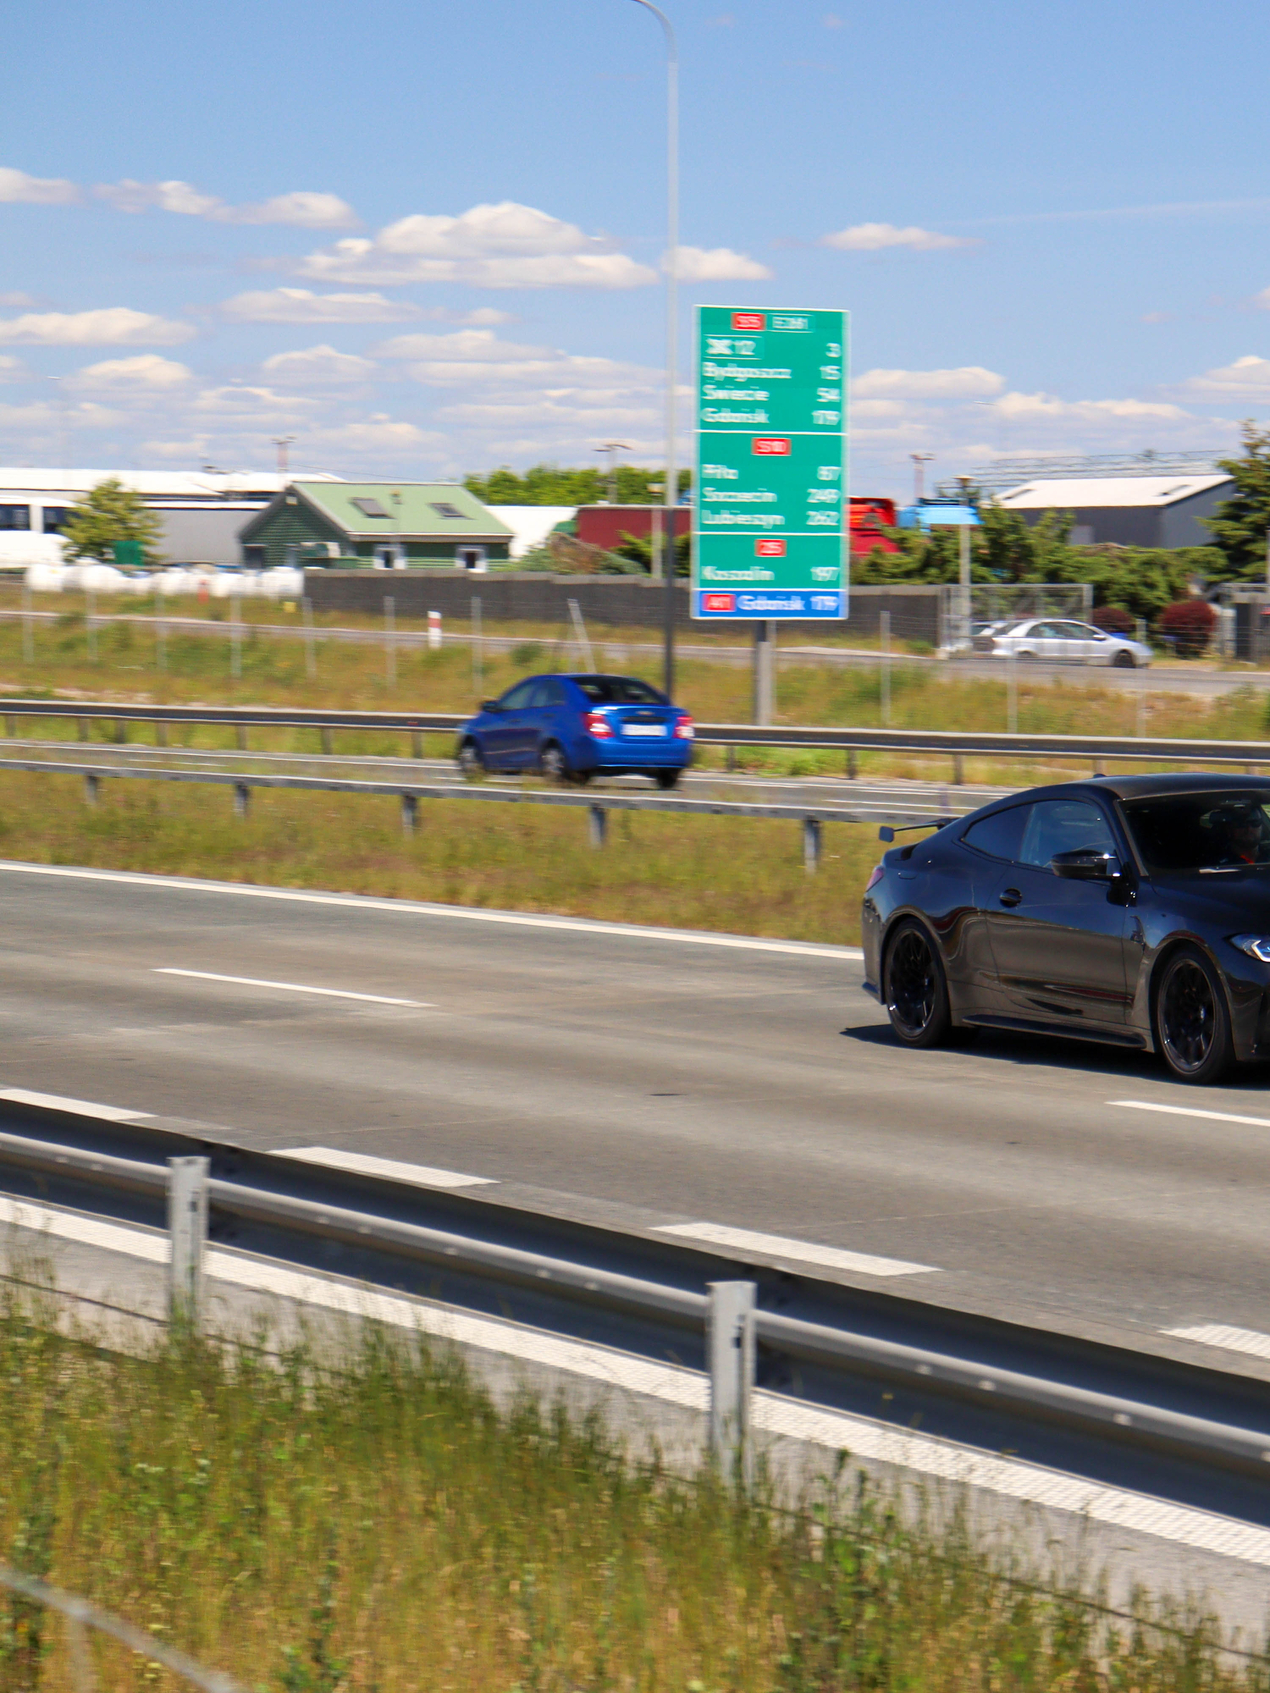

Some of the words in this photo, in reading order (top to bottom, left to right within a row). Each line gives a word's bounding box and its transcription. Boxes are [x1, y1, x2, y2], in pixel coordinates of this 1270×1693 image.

[826, 343, 841, 358] 3
[702, 361, 792, 382] Bydgoszcz
[819, 365, 841, 380] 15
[816, 387, 841, 403] 54
[701, 407, 770, 424] Gdańsk
[817, 465, 842, 481] 87
[702, 487, 777, 502] Szczecin
[760, 541, 783, 554] 25
[701, 565, 775, 581] Koszalin
[810, 566, 841, 581] 197
[737, 595, 806, 611] Gdańsk
[810, 596, 839, 611] 179
